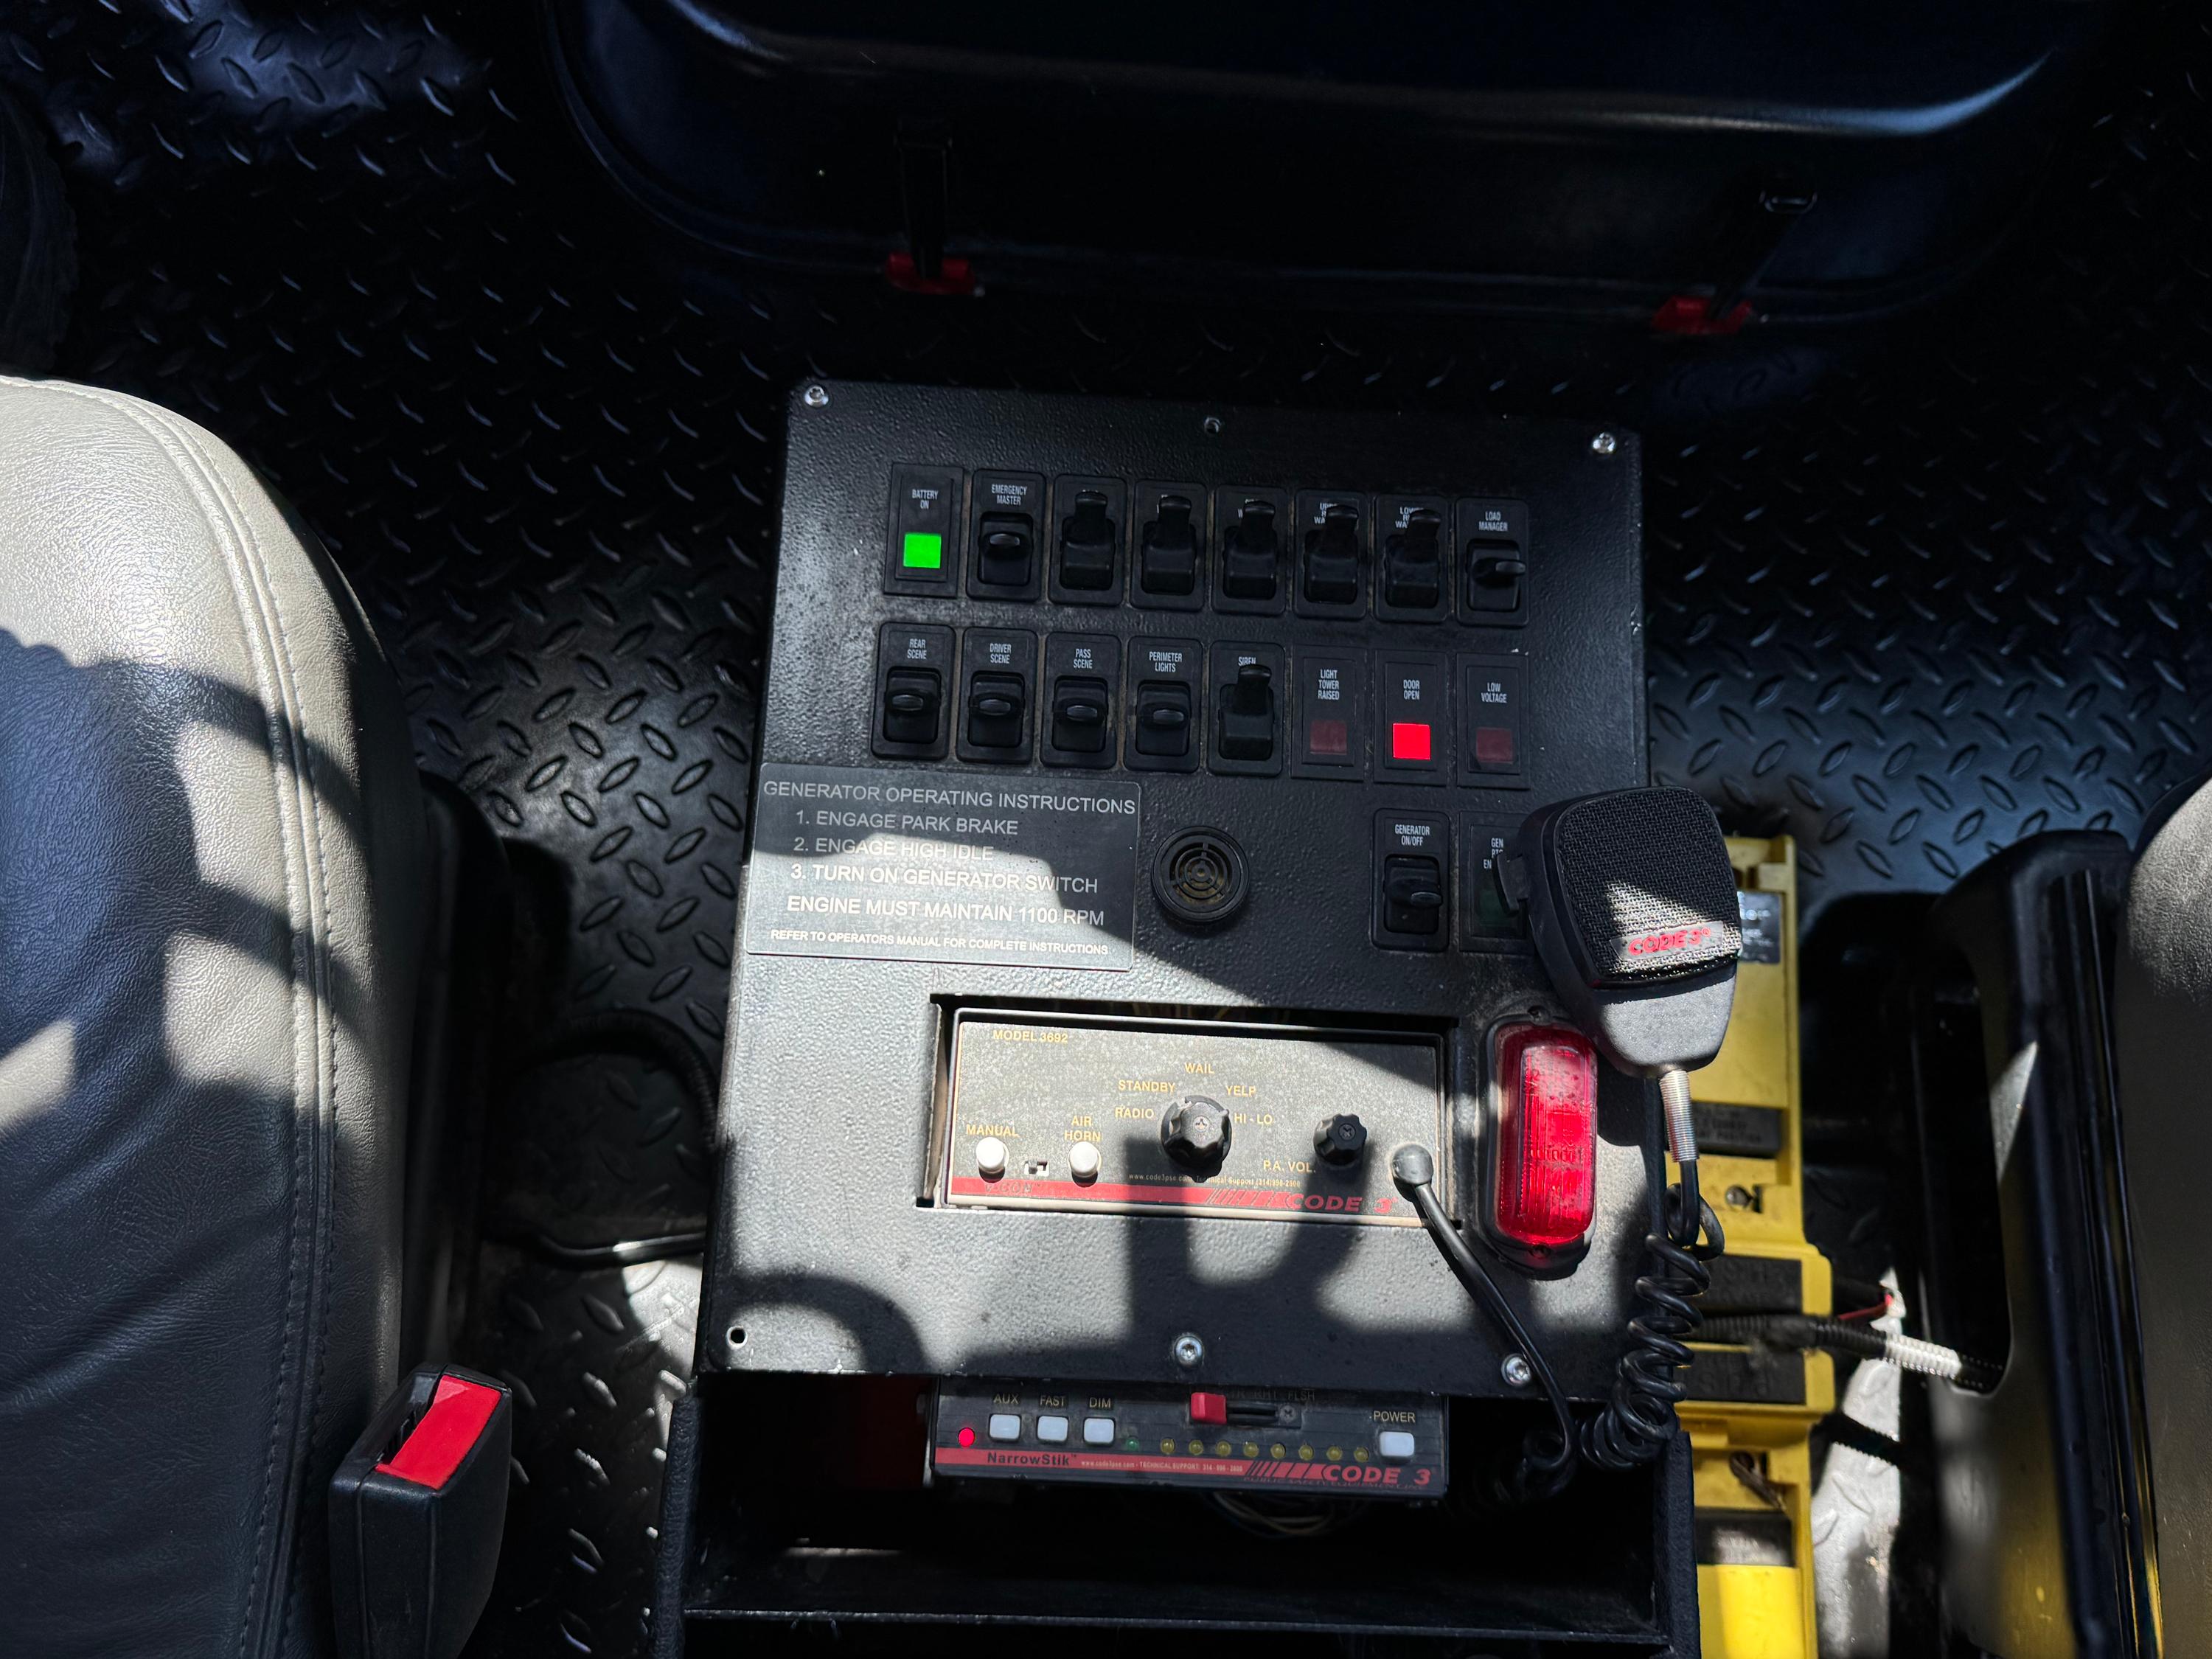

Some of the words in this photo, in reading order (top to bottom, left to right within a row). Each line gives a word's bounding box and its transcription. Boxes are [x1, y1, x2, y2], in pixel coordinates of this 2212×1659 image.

[912, 489, 938, 500] BATTERY
[992, 484, 1027, 495] EMERGENCY
[920, 500, 929, 509] ON
[997, 495, 1021, 506] MASTER
[1485, 511, 1500, 521] LOAD
[1479, 521, 1508, 532] MANAGER
[909, 639, 926, 650] REAR
[990, 643, 1012, 654] DRIVER
[907, 649, 927, 660] SCENE
[990, 653, 1010, 664] SCENE
[1076, 648, 1091, 659] PASS
[1149, 651, 1182, 663] PERIMETER
[1073, 658, 1093, 669] SCENE
[1155, 661, 1176, 672] LIGHTS
[1320, 669, 1338, 679] LIGHT
[1318, 679, 1340, 690] TOWER
[1403, 679, 1420, 690] DOOR
[1487, 683, 1501, 692] LOW
[1318, 689, 1340, 700] RAISED
[1403, 689, 1420, 700] OPEN
[1481, 692, 1507, 703] VOLTAGE
[764, 781, 880, 801] GENERATOR
[886, 787, 992, 807] OPERATING
[998, 793, 1135, 815] INSTRUCTIONS
[796, 810, 810, 825] 1.
[816, 810, 897, 829] ENGAGE
[902, 815, 950, 832] PARK
[956, 817, 1018, 835] BRAKE
[1395, 824, 1430, 835] GENERATOR
[1401, 835, 1424, 846] ON/OFF
[1491, 838, 1503, 849] GEN
[793, 838, 809, 852] 2.
[815, 838, 897, 856] ENGAGE
[900, 841, 947, 859] HIGH
[953, 845, 994, 861] IDLE
[790, 863, 807, 880] 3.
[813, 864, 864, 883] TURN
[869, 867, 898, 883] ON
[903, 869, 1020, 889] GENERATOR
[1025, 874, 1098, 894] SWITCH
[787, 895, 861, 914] ENGINE
[866, 899, 920, 917] MUST
[924, 902, 1012, 922] MAINTAIN
[1018, 907, 1058, 923] 1100
[1063, 908, 1105, 926] RPM
[771, 929, 808, 941] REFER
[810, 931, 826, 942] TO
[828, 932, 894, 945] OPERATORS
[897, 935, 941, 947] MANUAL
[944, 936, 967, 947] FOR
[968, 939, 1027, 950] COMPLETE
[1029, 941, 1109, 955] INSTRUCTIONS
[1628, 930, 1688, 956] CODE
[992, 1029, 1037, 1043] MODEL
[1040, 1032, 1068, 1045] 3692
[1184, 1062, 1215, 1074] WAIL
[1118, 1079, 1175, 1093] STANDBY
[1225, 1085, 1256, 1097] YELP
[1115, 1107, 1155, 1119] RADIO
[1071, 1116, 1093, 1127] AIR
[1234, 1113, 1247, 1124] HI
[1257, 1113, 1273, 1125] LO
[966, 1124, 1020, 1138] MANUAL
[1064, 1129, 1102, 1142] HORN
[1263, 1160, 1284, 1172] P.A.
[1288, 1161, 1316, 1174] VOL.
[1286, 1192, 1363, 1213] CODE
[1374, 1197, 1393, 1214] 3
[993, 1394, 1019, 1405] AUX
[1040, 1395, 1066, 1407] FAST
[1089, 1397, 1111, 1408] DIM
[1374, 1410, 1416, 1423] POWER
[1140, 1461, 1171, 1469] TECHNICAL
[1323, 1464, 1401, 1484] CODE
[1413, 1468, 1432, 1485] 3
